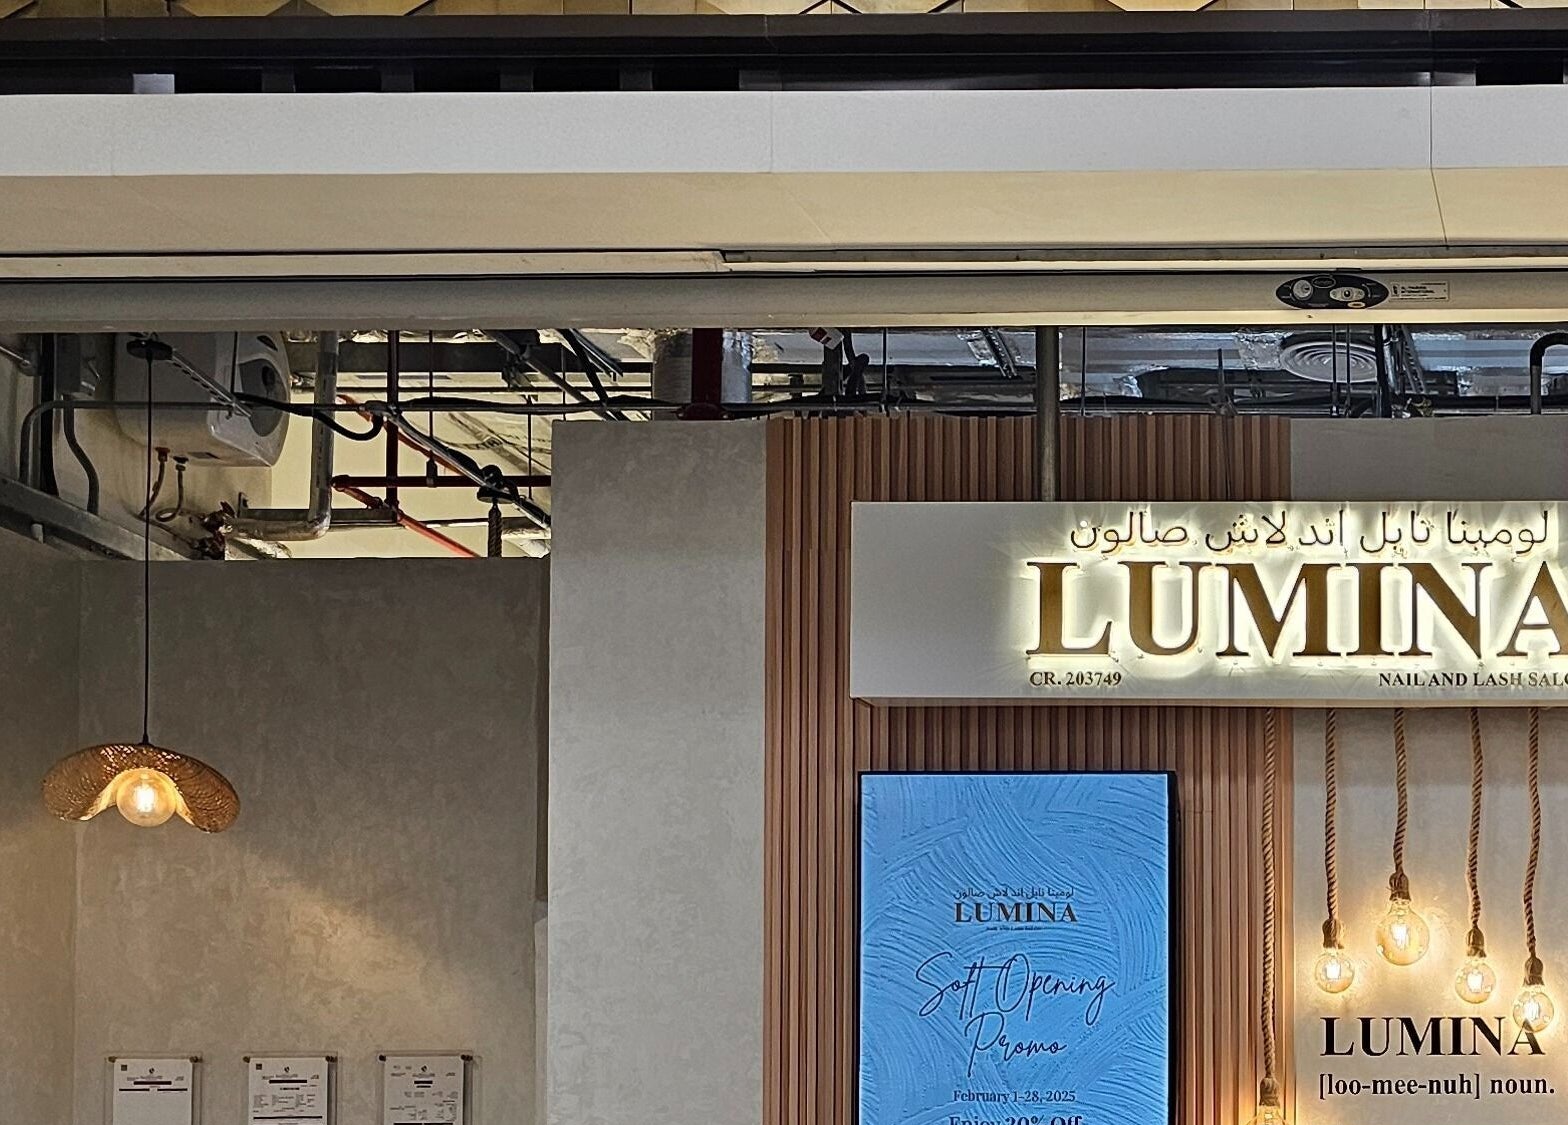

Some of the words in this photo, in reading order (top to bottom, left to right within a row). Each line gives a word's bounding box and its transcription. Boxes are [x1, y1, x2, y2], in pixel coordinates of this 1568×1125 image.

[1029, 671, 1062, 687] CR.
[1065, 671, 1122, 687] 203749
[1379, 672, 1425, 687] NAIL
[1427, 672, 1468, 687] AND
[1472, 672, 1523, 687] LASH
[955, 902, 1078, 922] LUMINA
[916, 951, 1008, 1020] Soft
[996, 953, 1116, 1026] Opening
[964, 1011, 1068, 1078] Promo
[1319, 1016, 1546, 1057] LUMINA
[953, 1089, 1010, 1104] February
[1046, 1090, 1076, 1102] 2025
[1319, 1073, 1480, 1101] [loo-mee-nuh]
[1490, 1078, 1555, 1095] noun.
